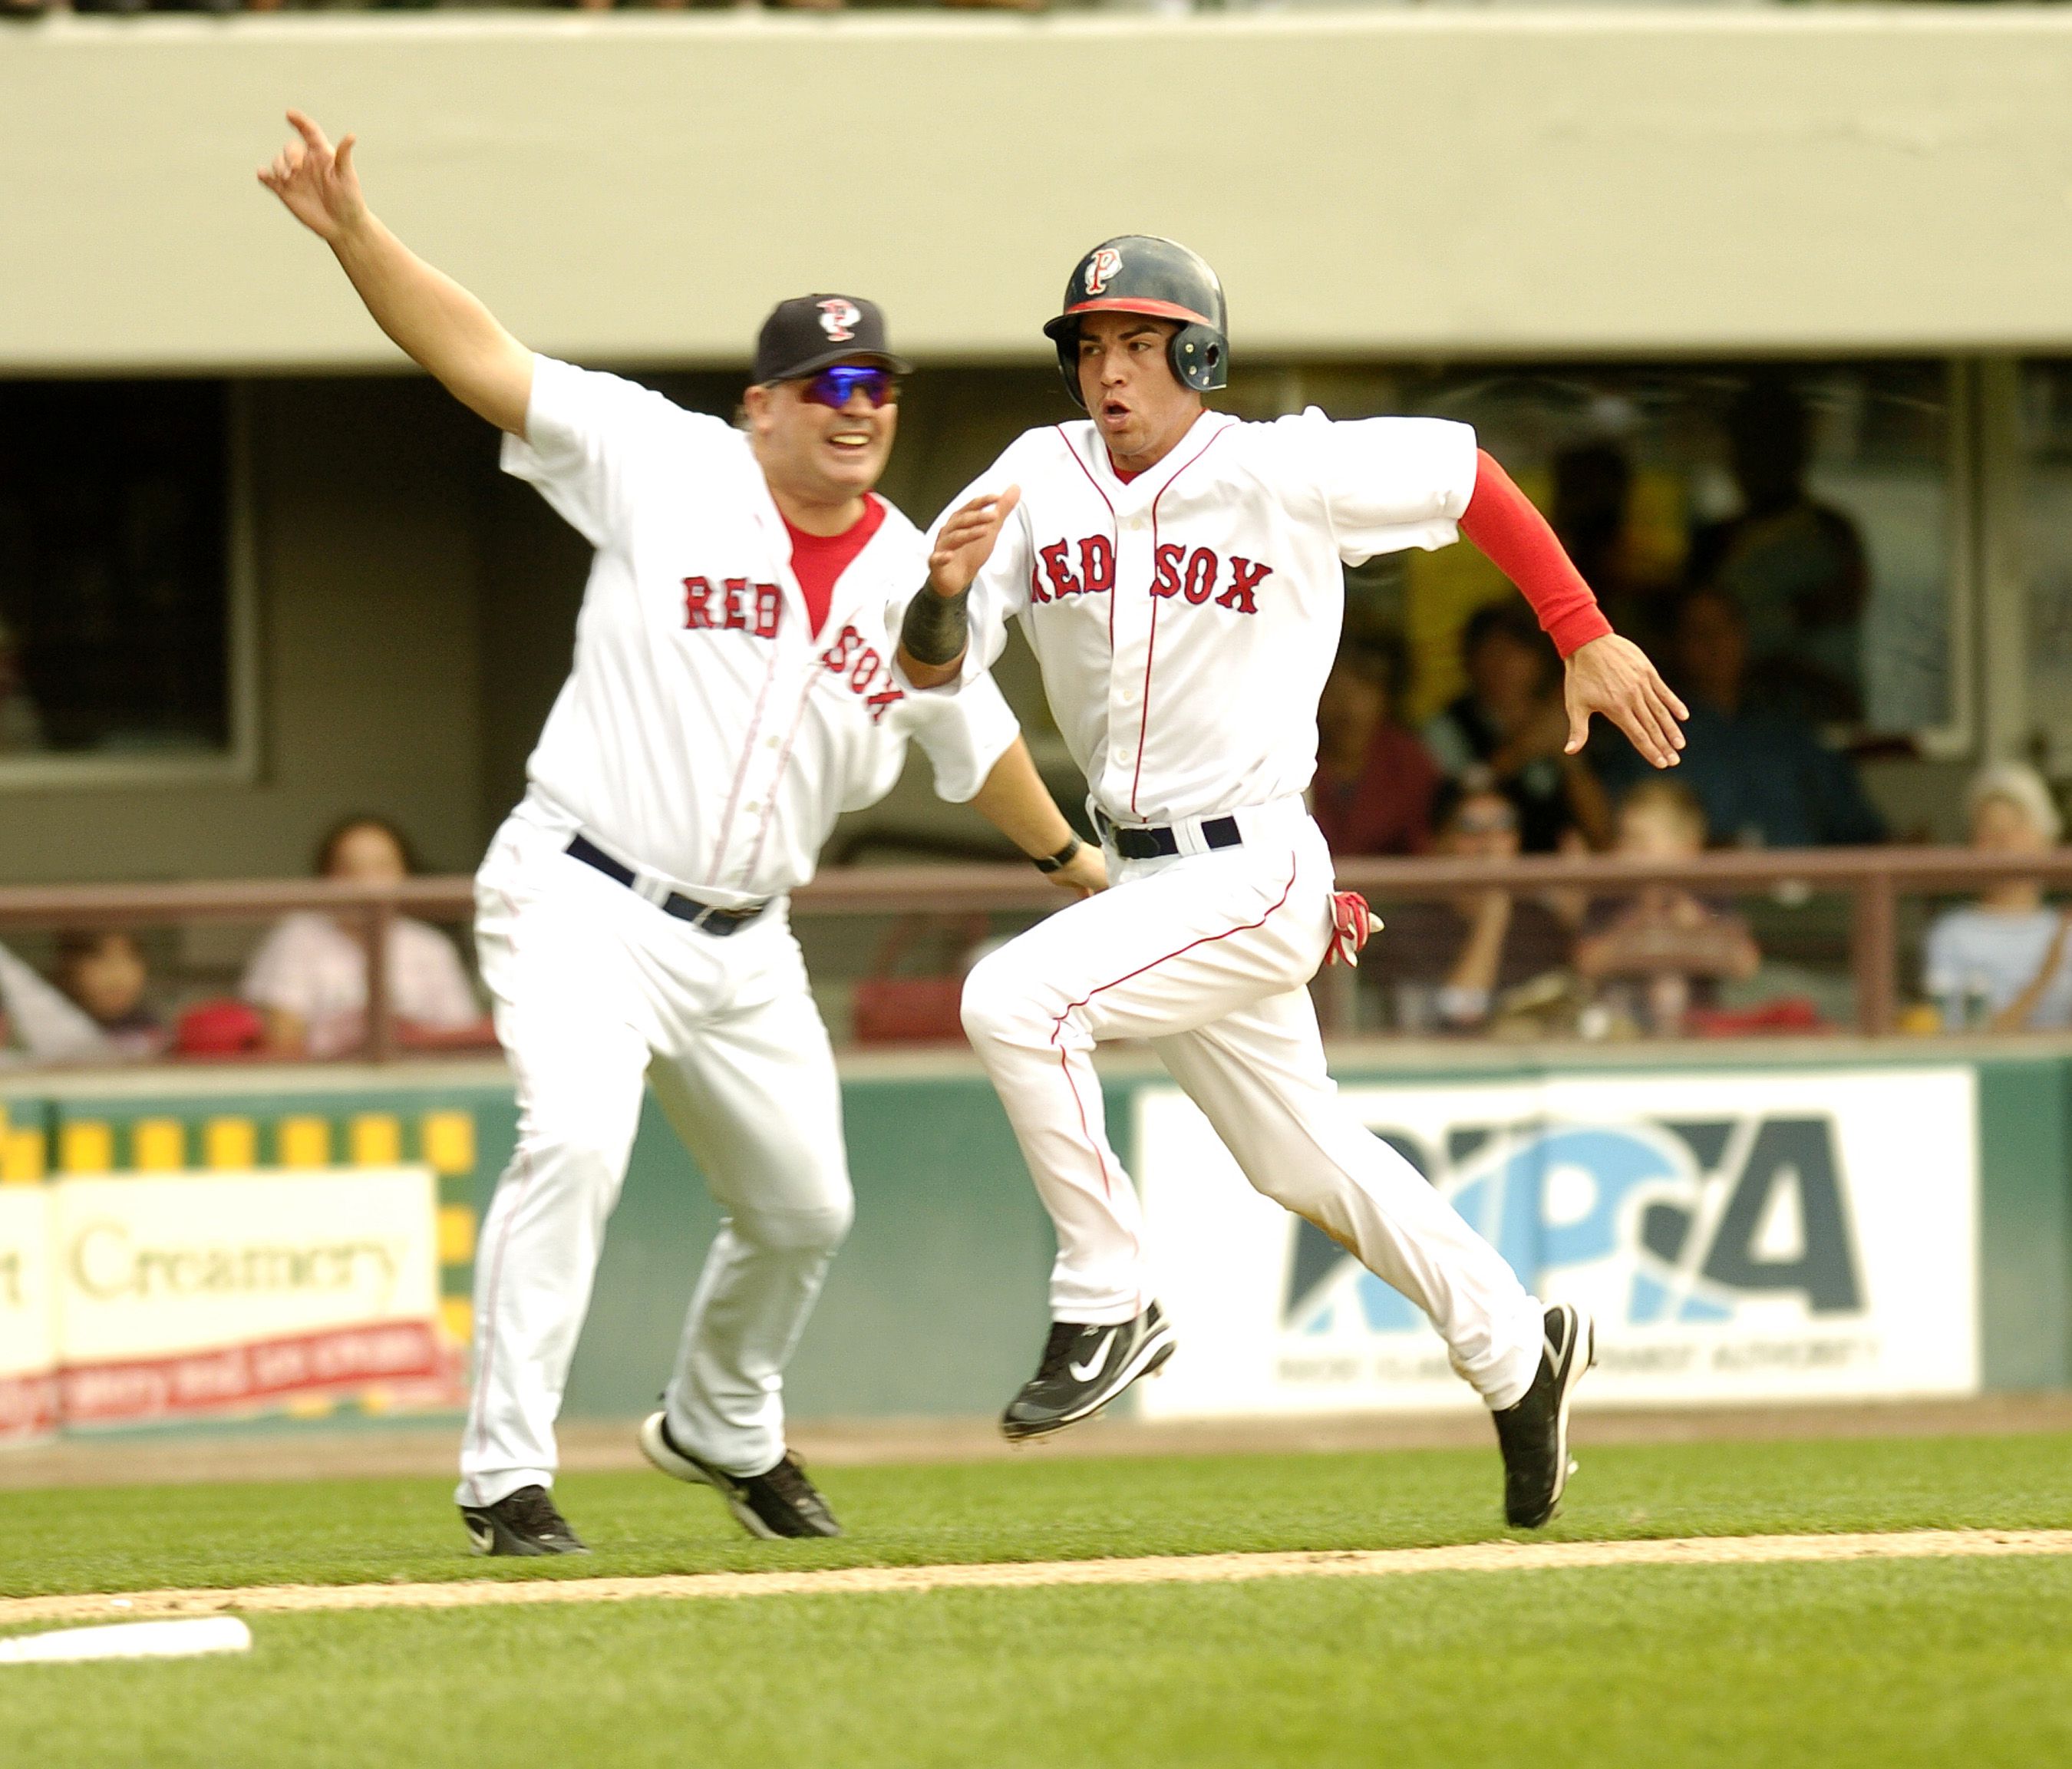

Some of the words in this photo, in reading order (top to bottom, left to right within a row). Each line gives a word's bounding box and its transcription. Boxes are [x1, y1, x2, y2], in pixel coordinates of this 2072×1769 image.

[1084, 248, 1123, 295] P
[1150, 543, 1273, 614] SOX
[682, 576, 783, 639] RED
[821, 625, 904, 724] SOX
[66, 1221, 407, 1312] Creamery
